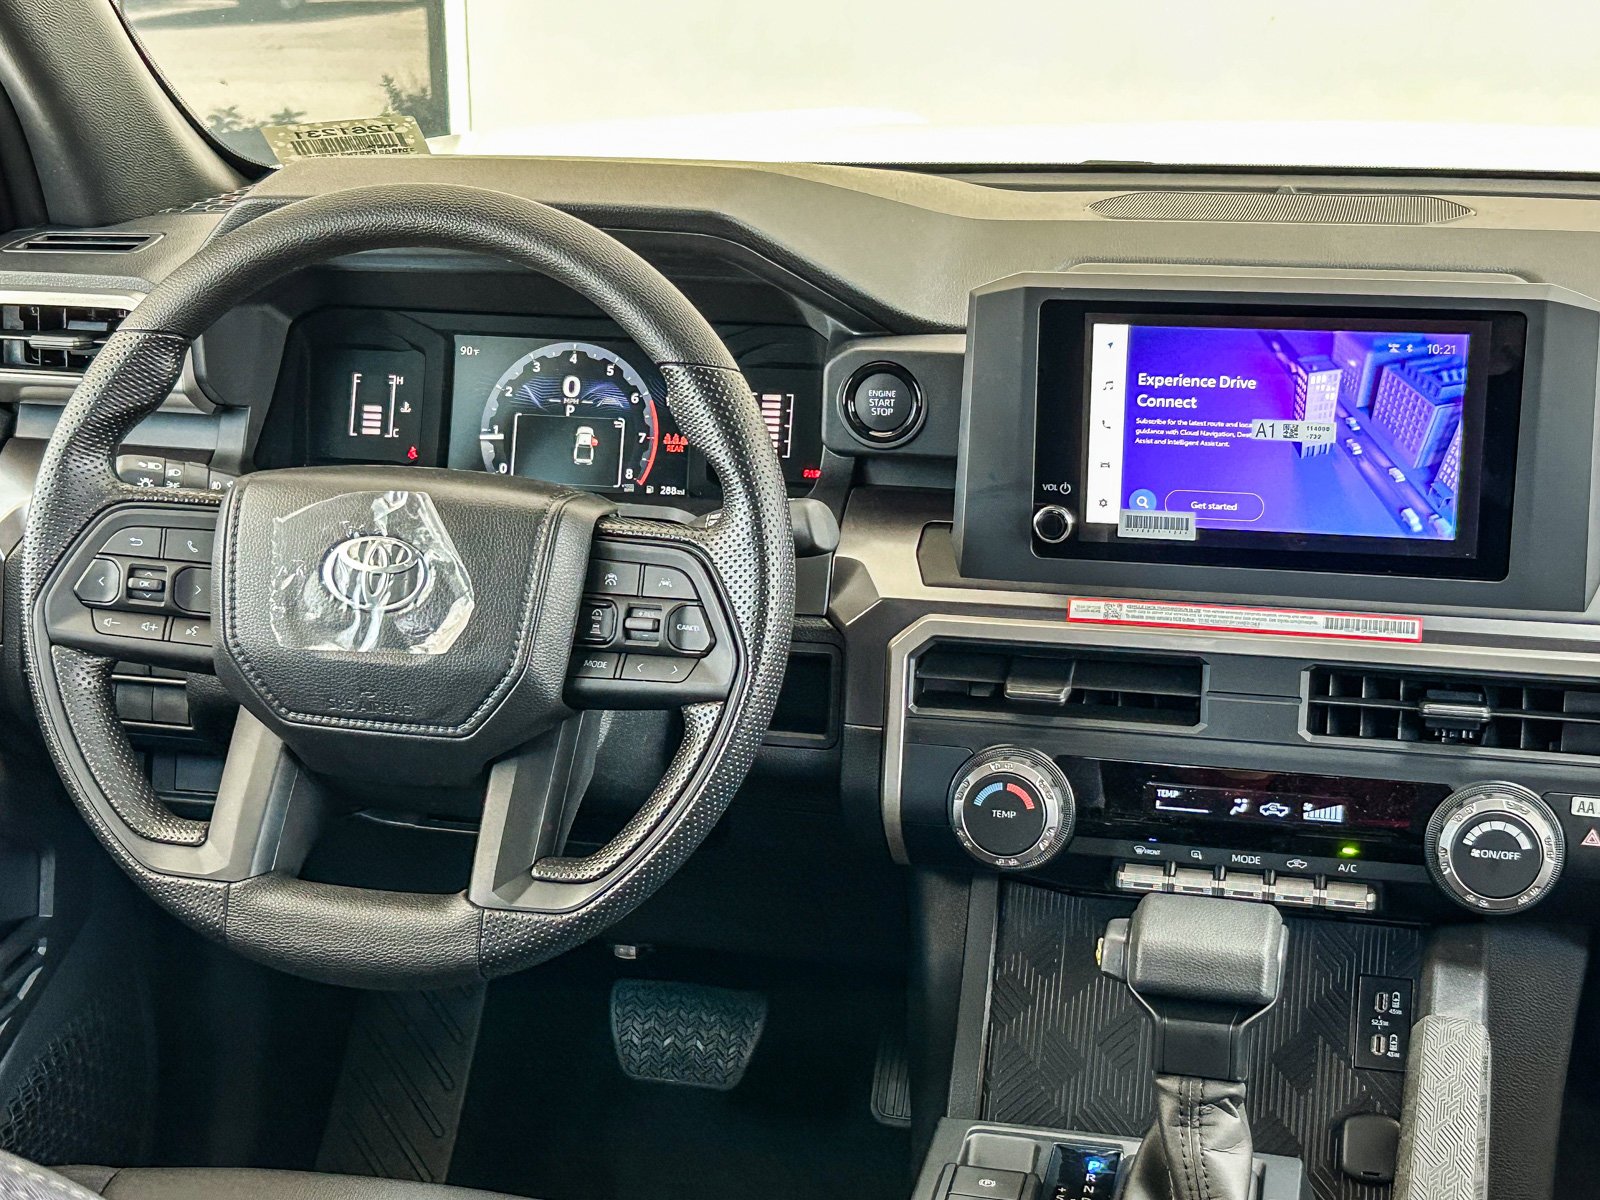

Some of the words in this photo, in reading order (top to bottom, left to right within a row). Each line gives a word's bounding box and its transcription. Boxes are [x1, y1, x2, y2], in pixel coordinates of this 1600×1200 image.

[1427, 343, 1456, 355] 10:21
[569, 354, 577, 364] 4
[532, 362, 541, 372] 3
[606, 366, 615, 376] 5
[1138, 372, 1216, 389] Experience
[1219, 375, 1257, 389] Drive
[562, 375, 581, 398] 0
[505, 387, 513, 397] 2
[868, 390, 897, 398] ENGINE
[631, 393, 640, 404] 6
[869, 399, 895, 407] START
[1137, 394, 1197, 409] Connect
[566, 405, 575, 416] P
[871, 408, 894, 416] STOP
[1135, 417, 1166, 425] Subscribe
[493, 425, 499, 434] 1
[1255, 422, 1275, 438] A1
[638, 433, 647, 443] 7
[499, 463, 507, 473] 0
[625, 468, 633, 479] 8
[1042, 483, 1058, 491] VOL
[1190, 501, 1206, 510] Get
[1208, 502, 1238, 511] started
[584, 659, 608, 669] MODE
[1157, 789, 1179, 798] TEMP
[992, 809, 1017, 819] TEMP
[1231, 854, 1261, 865] MODE
[1480, 850, 1521, 861] ON/OFF
[1338, 863, 1357, 873] A/C
[1088, 1161, 1100, 1171] P
[1085, 1173, 1096, 1182] R
[1083, 1185, 1095, 1194] N
